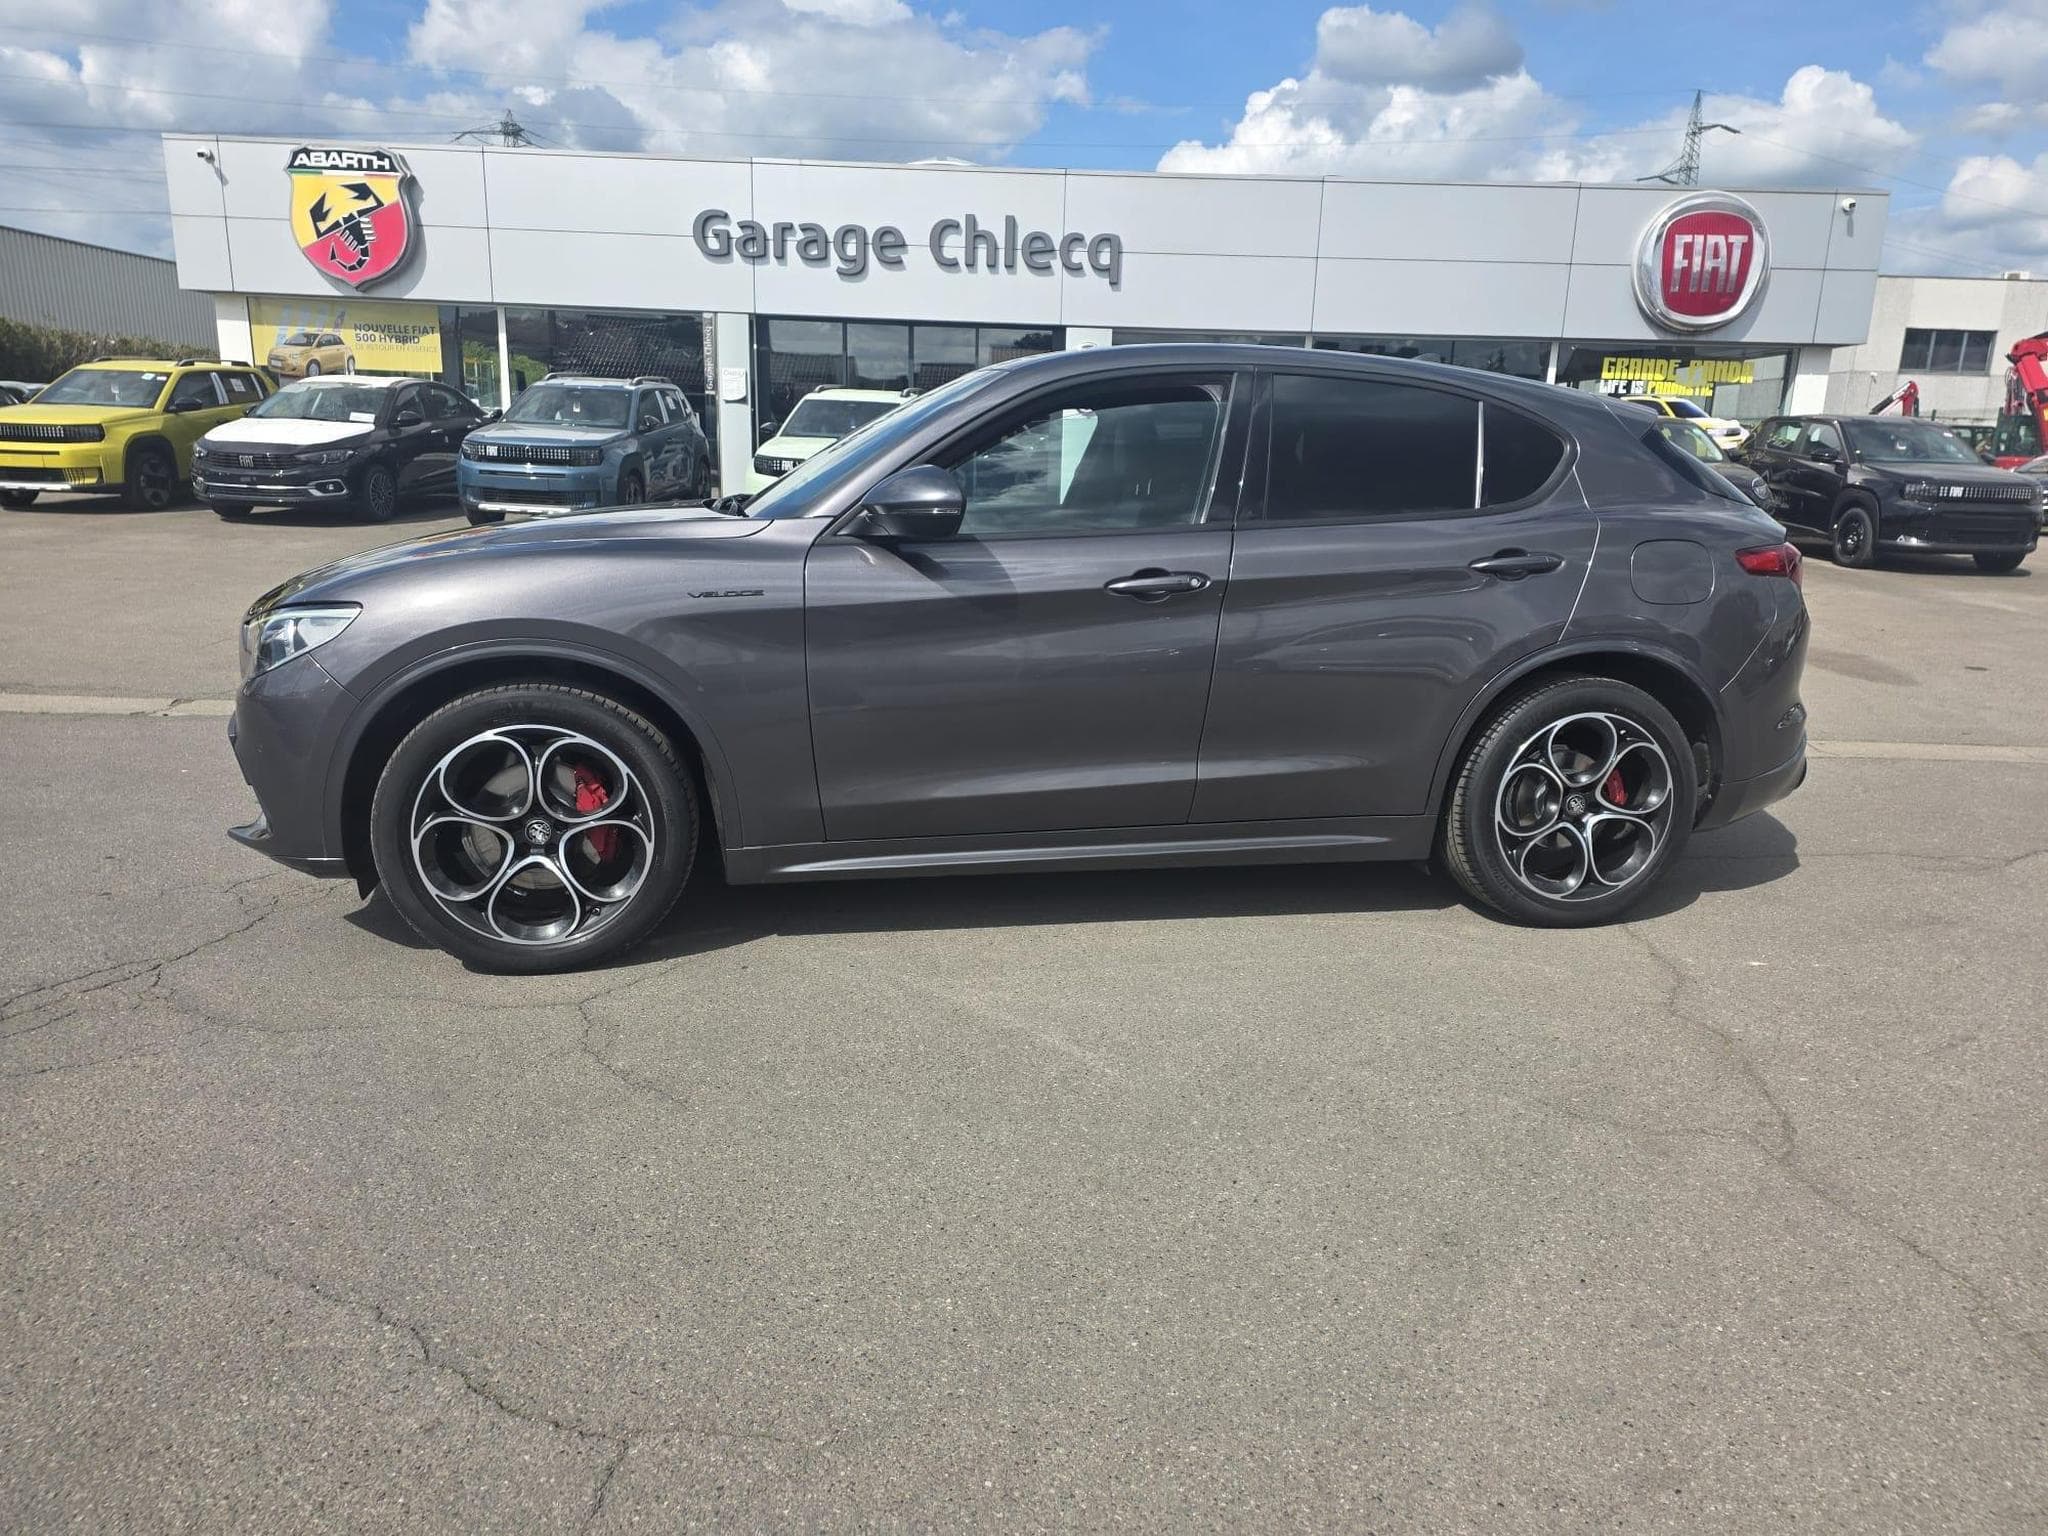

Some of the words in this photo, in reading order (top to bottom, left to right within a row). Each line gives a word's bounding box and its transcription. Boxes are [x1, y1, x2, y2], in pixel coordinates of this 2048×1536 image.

[293, 151, 390, 169] ABARTH
[693, 208, 906, 276] Garage
[929, 213, 1122, 285] Chlecq
[1669, 233, 1749, 293] FIAT
[354, 323, 410, 335] NOUVELLE
[412, 325, 436, 335] FIAT
[355, 333, 377, 343] 500
[380, 334, 420, 345] HYBRID
[1601, 356, 1683, 381] GRANDE
[1688, 359, 1755, 384] PANDA
[1599, 379, 1628, 395] LIFE
[1631, 380, 1644, 395] IS
[239, 455, 254, 468] FIAT
[687, 589, 764, 599] VELOCE
